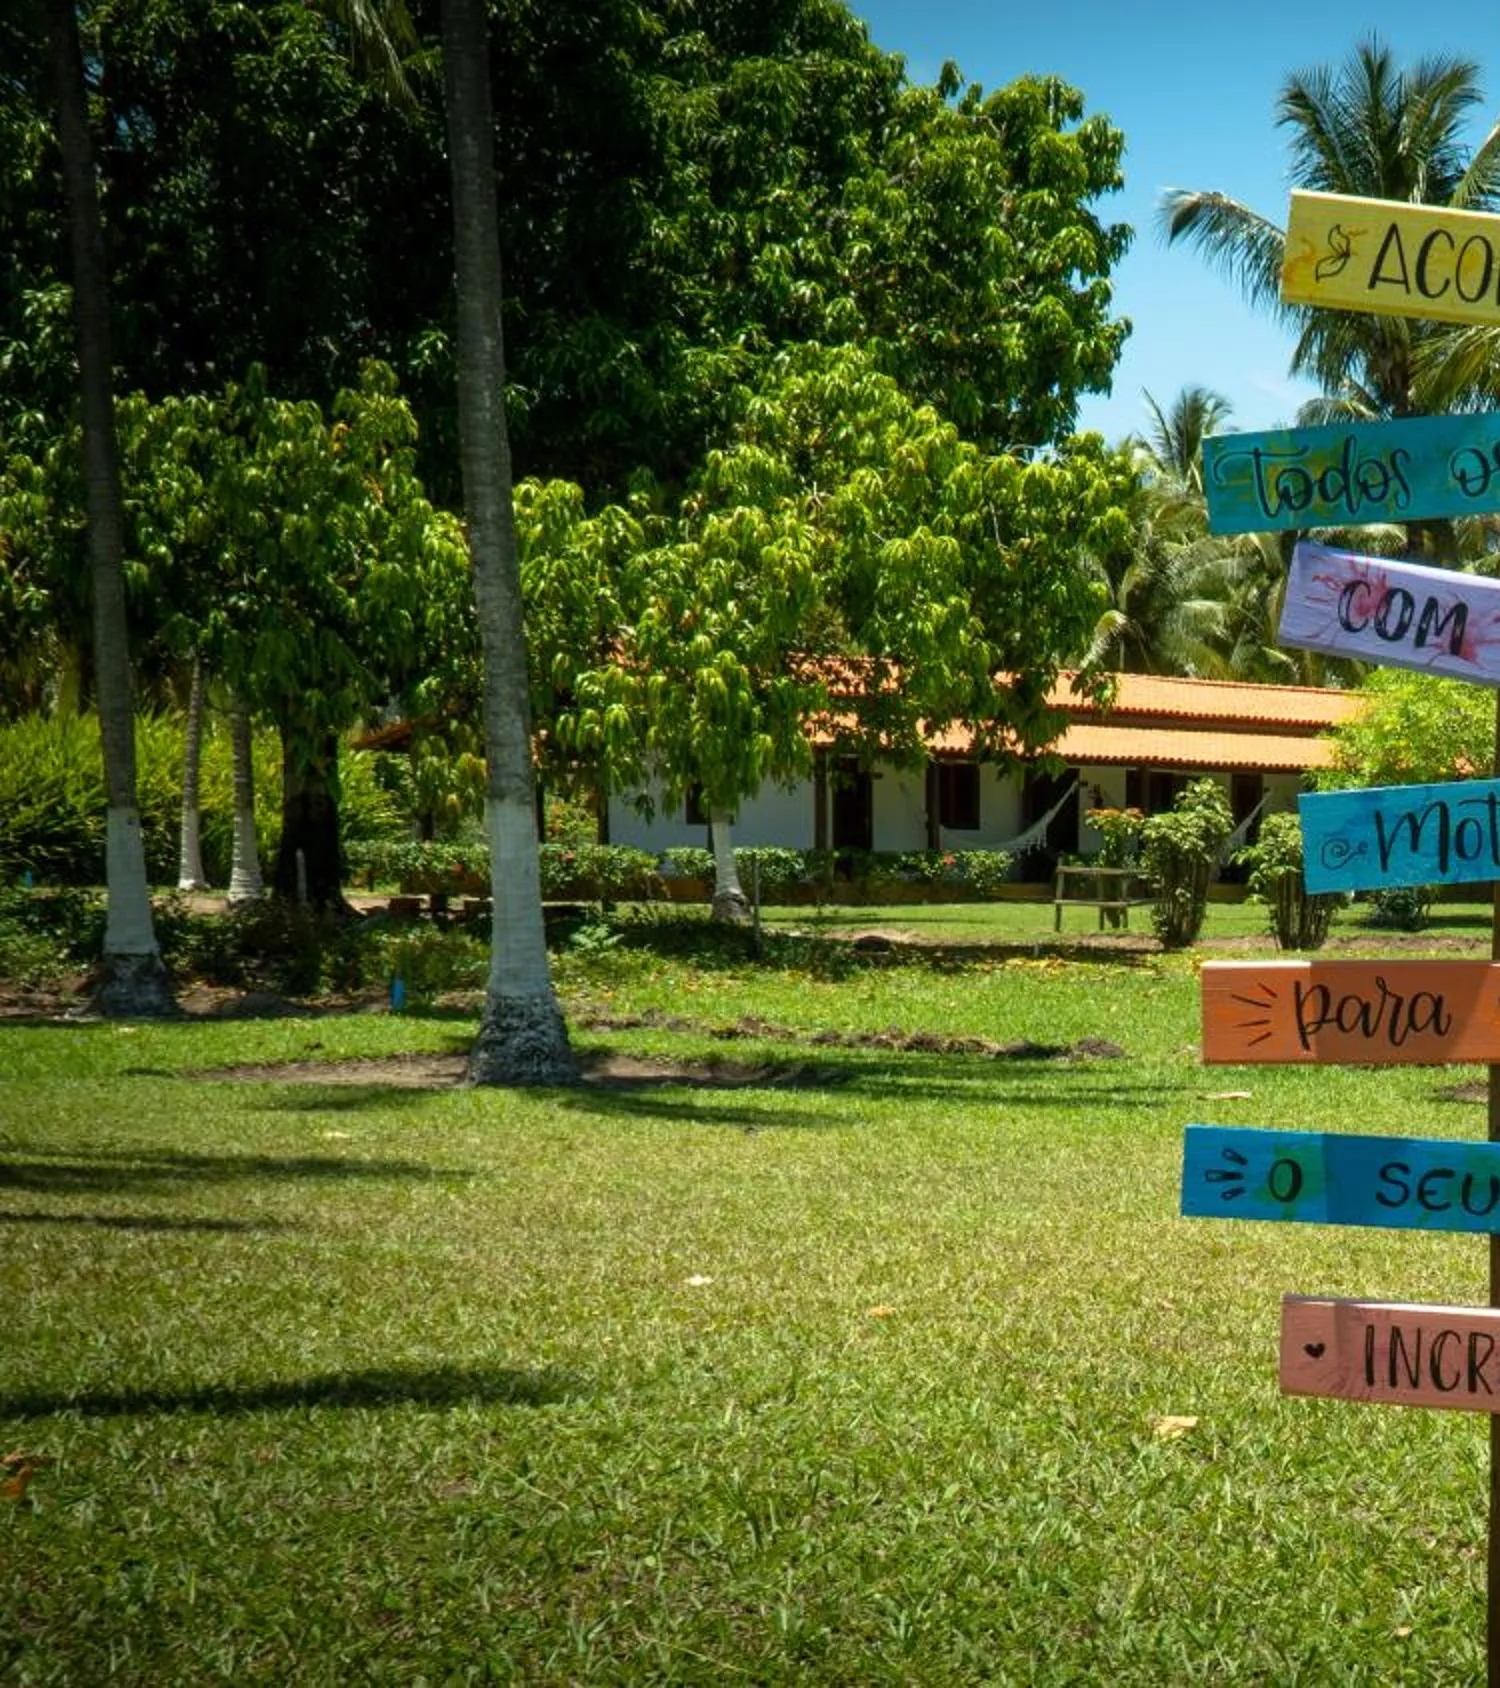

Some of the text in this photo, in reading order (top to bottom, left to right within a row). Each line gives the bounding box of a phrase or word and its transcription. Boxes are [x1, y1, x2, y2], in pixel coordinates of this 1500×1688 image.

[1337, 579, 1469, 656] COM
[1293, 975, 1451, 1051] para
[1267, 1157, 1303, 1203] O
[1375, 1161, 1500, 1217] SEU
